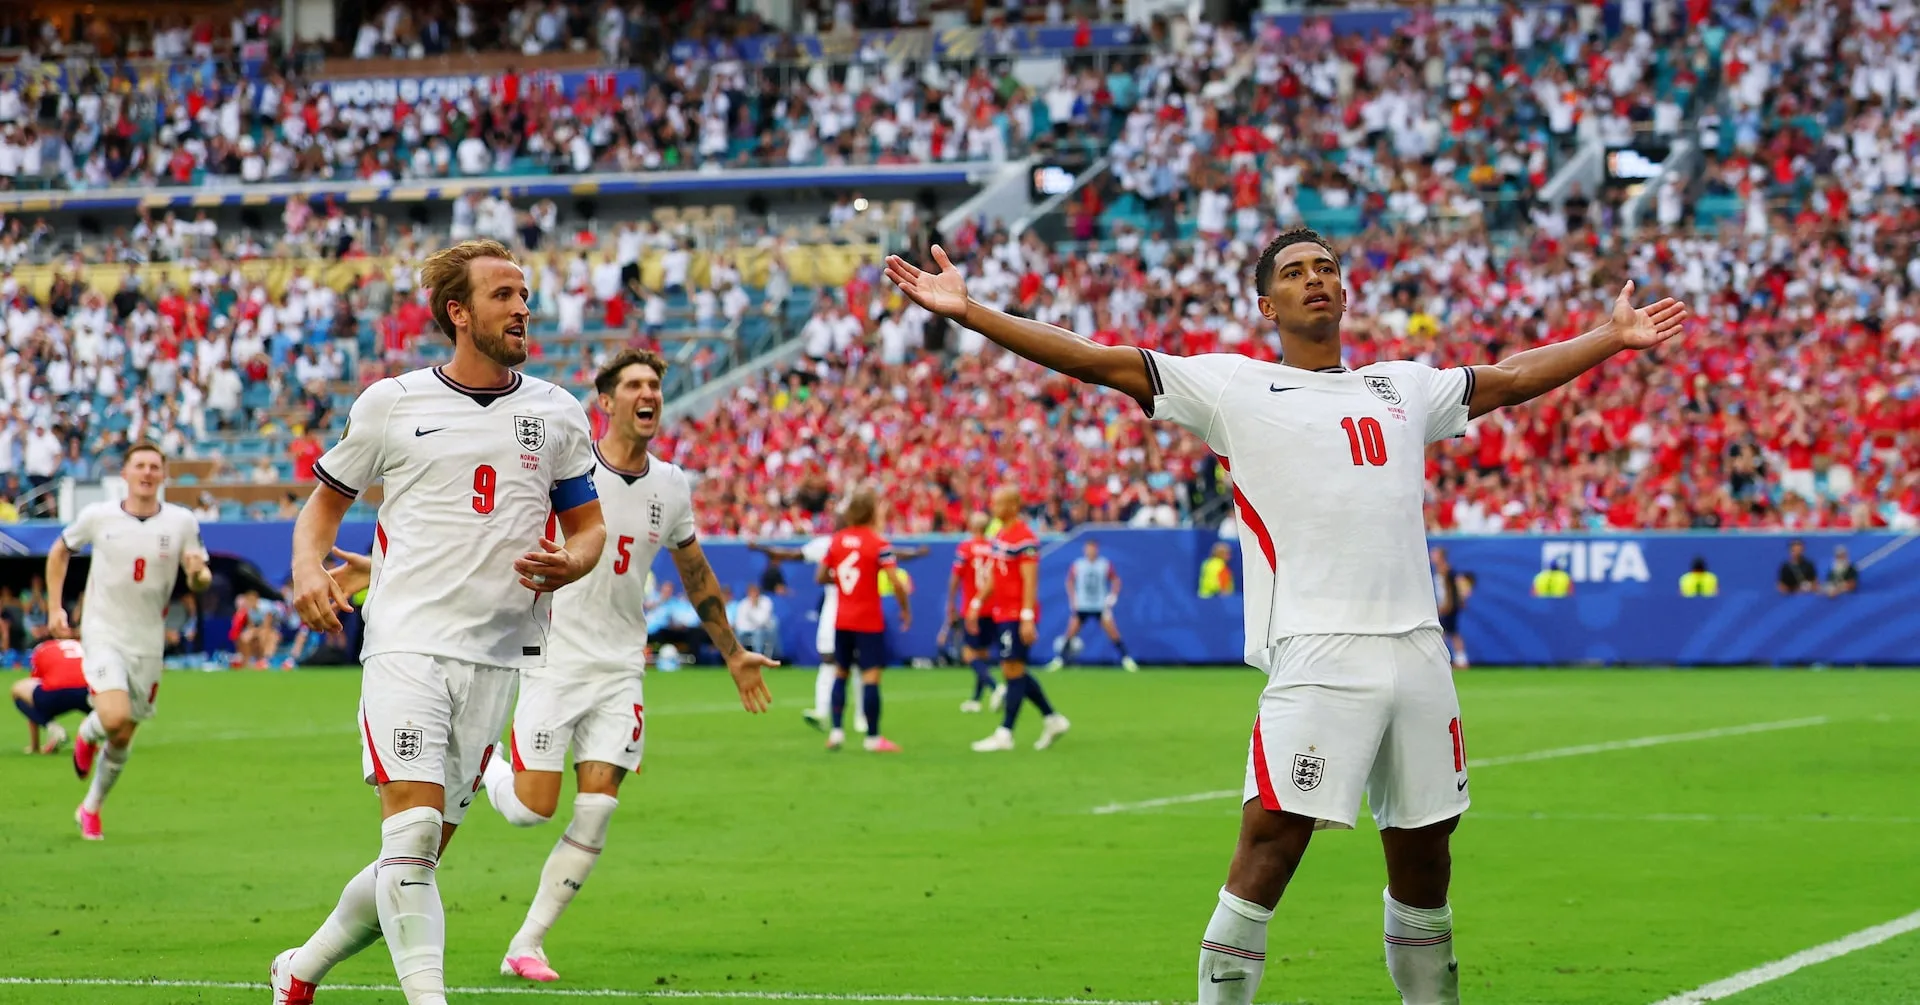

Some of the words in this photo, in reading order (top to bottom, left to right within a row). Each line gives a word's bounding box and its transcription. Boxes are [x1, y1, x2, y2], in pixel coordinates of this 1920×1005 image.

[1340, 416, 1388, 466] 10
[472, 464, 497, 515] 9
[133, 557, 146, 582] 8
[613, 534, 635, 575] 5
[836, 549, 861, 596] 6
[1542, 540, 1651, 582] FIFA
[632, 703, 644, 742] 5
